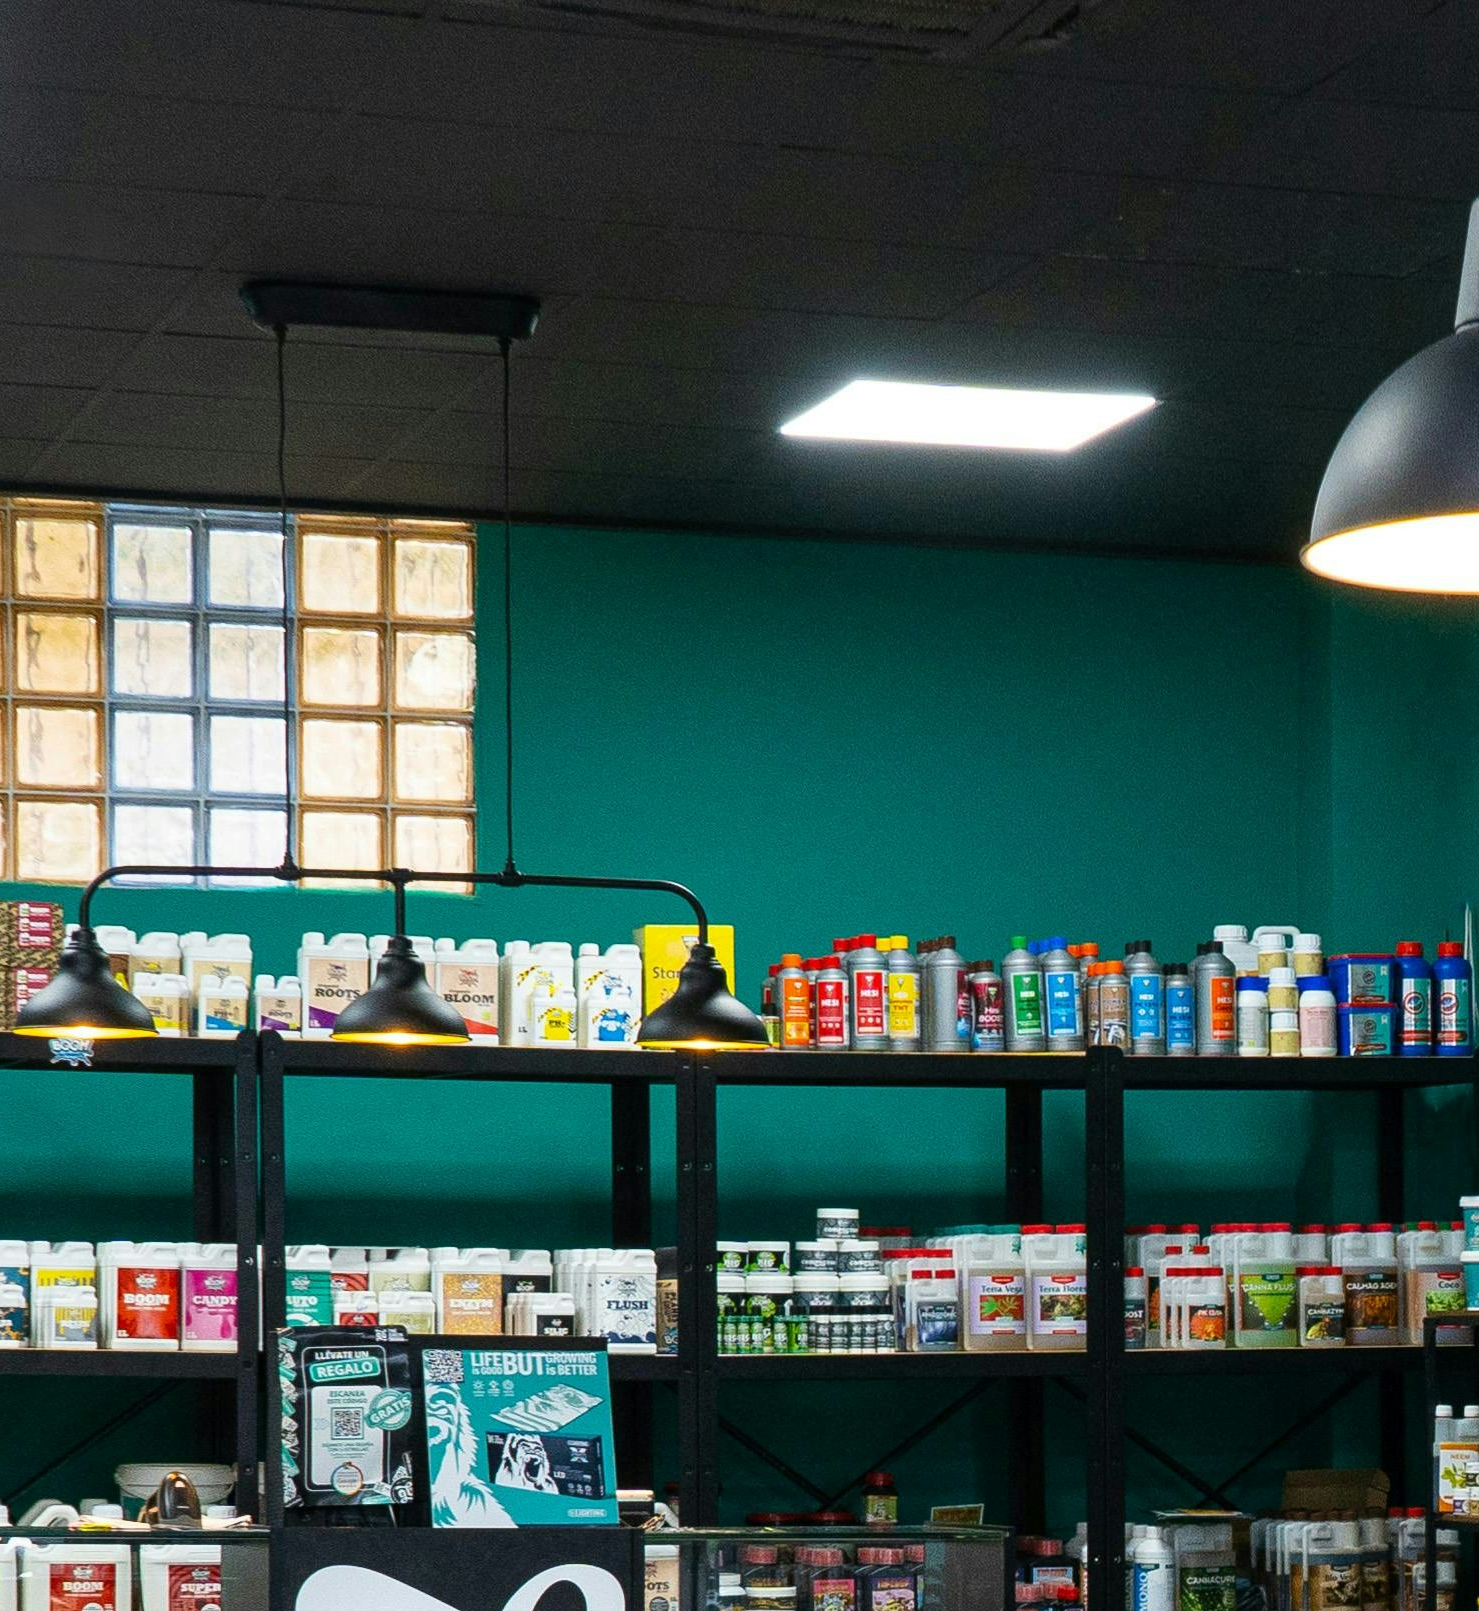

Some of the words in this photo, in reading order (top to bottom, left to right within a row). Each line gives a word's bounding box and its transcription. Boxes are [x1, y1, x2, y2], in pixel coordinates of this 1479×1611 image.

[443, 993, 495, 1003] BLOOM
[123, 1294, 170, 1305] BOOM
[606, 1300, 648, 1310] FLUSH
[314, 1350, 352, 1360] LLÉVATE
[354, 1350, 369, 1359] UN
[471, 1352, 503, 1367] LIFE
[545, 1352, 597, 1364] GROWING
[503, 1352, 545, 1376] BUT
[317, 1362, 373, 1379] REGALO
[557, 1365, 597, 1376] BETTER
[369, 1395, 412, 1424] GRATIS
[62, 1580, 104, 1592] BOOM
[1137, 1572, 1150, 1610] MONO
